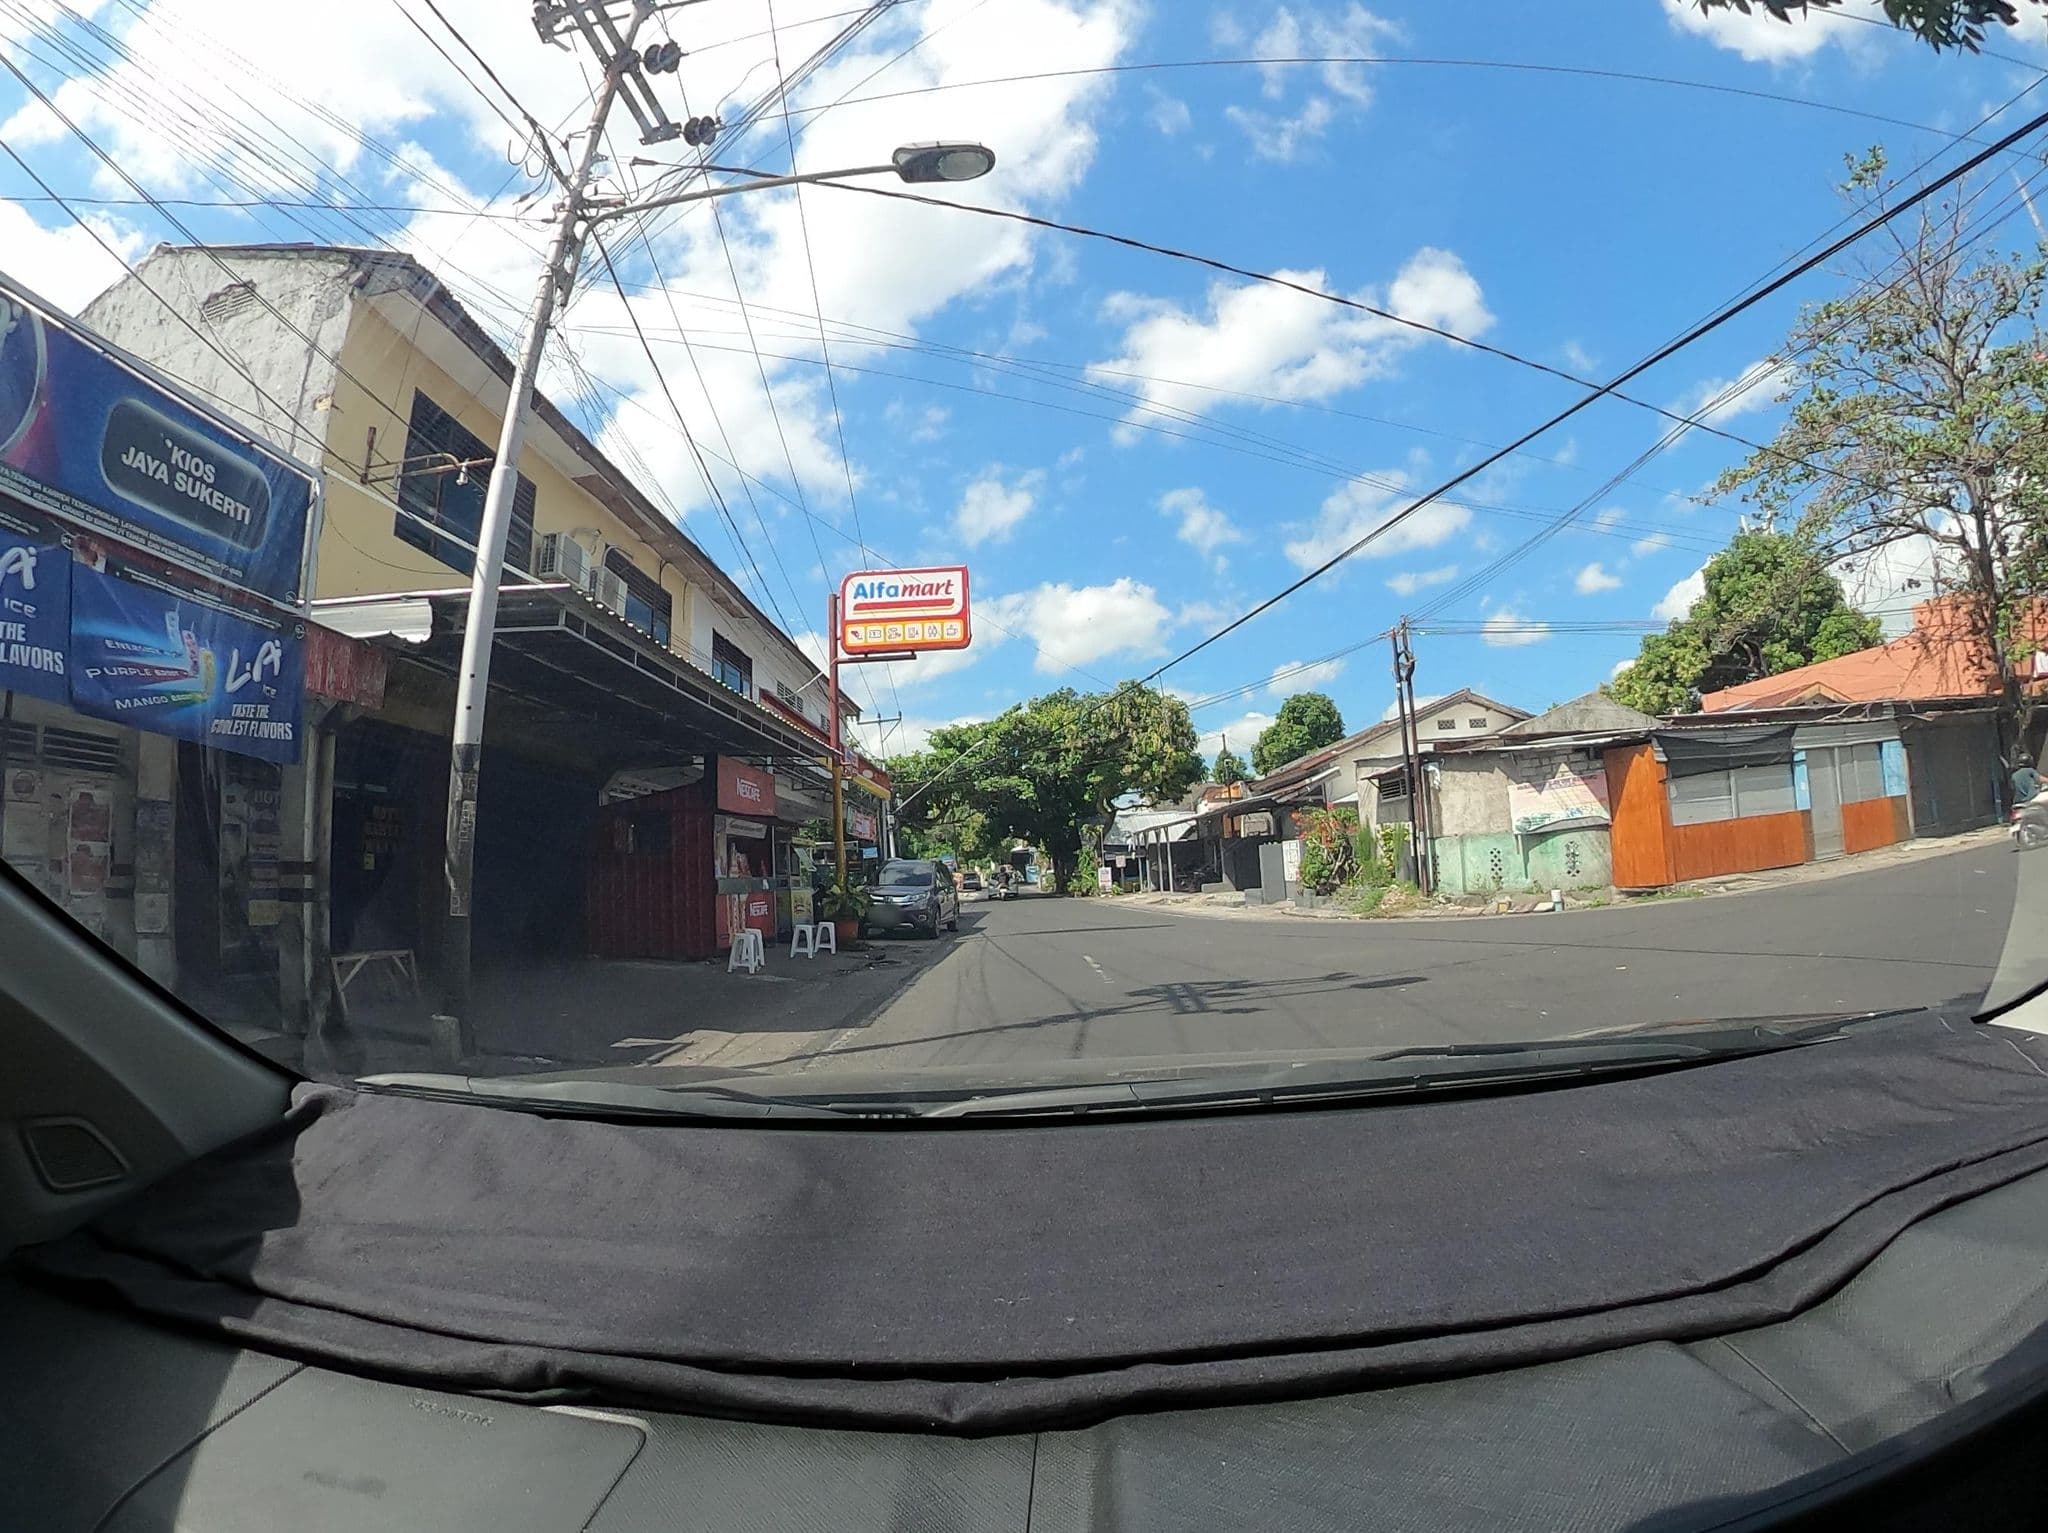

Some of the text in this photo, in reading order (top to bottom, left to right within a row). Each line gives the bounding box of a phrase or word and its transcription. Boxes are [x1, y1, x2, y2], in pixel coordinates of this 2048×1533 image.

[121, 446, 169, 485] JAYA
[174, 471, 251, 525] SUKERTI
[854, 579, 954, 600] Alfamart
[4, 598, 37, 619] ICE
[0, 621, 26, 641] THE
[85, 667, 153, 679] PURPLE
[262, 684, 278, 699] ICE
[114, 695, 169, 710] MANGO
[231, 703, 271, 719] TASTE THE
[210, 718, 294, 741] COOLEST FLAVORS
